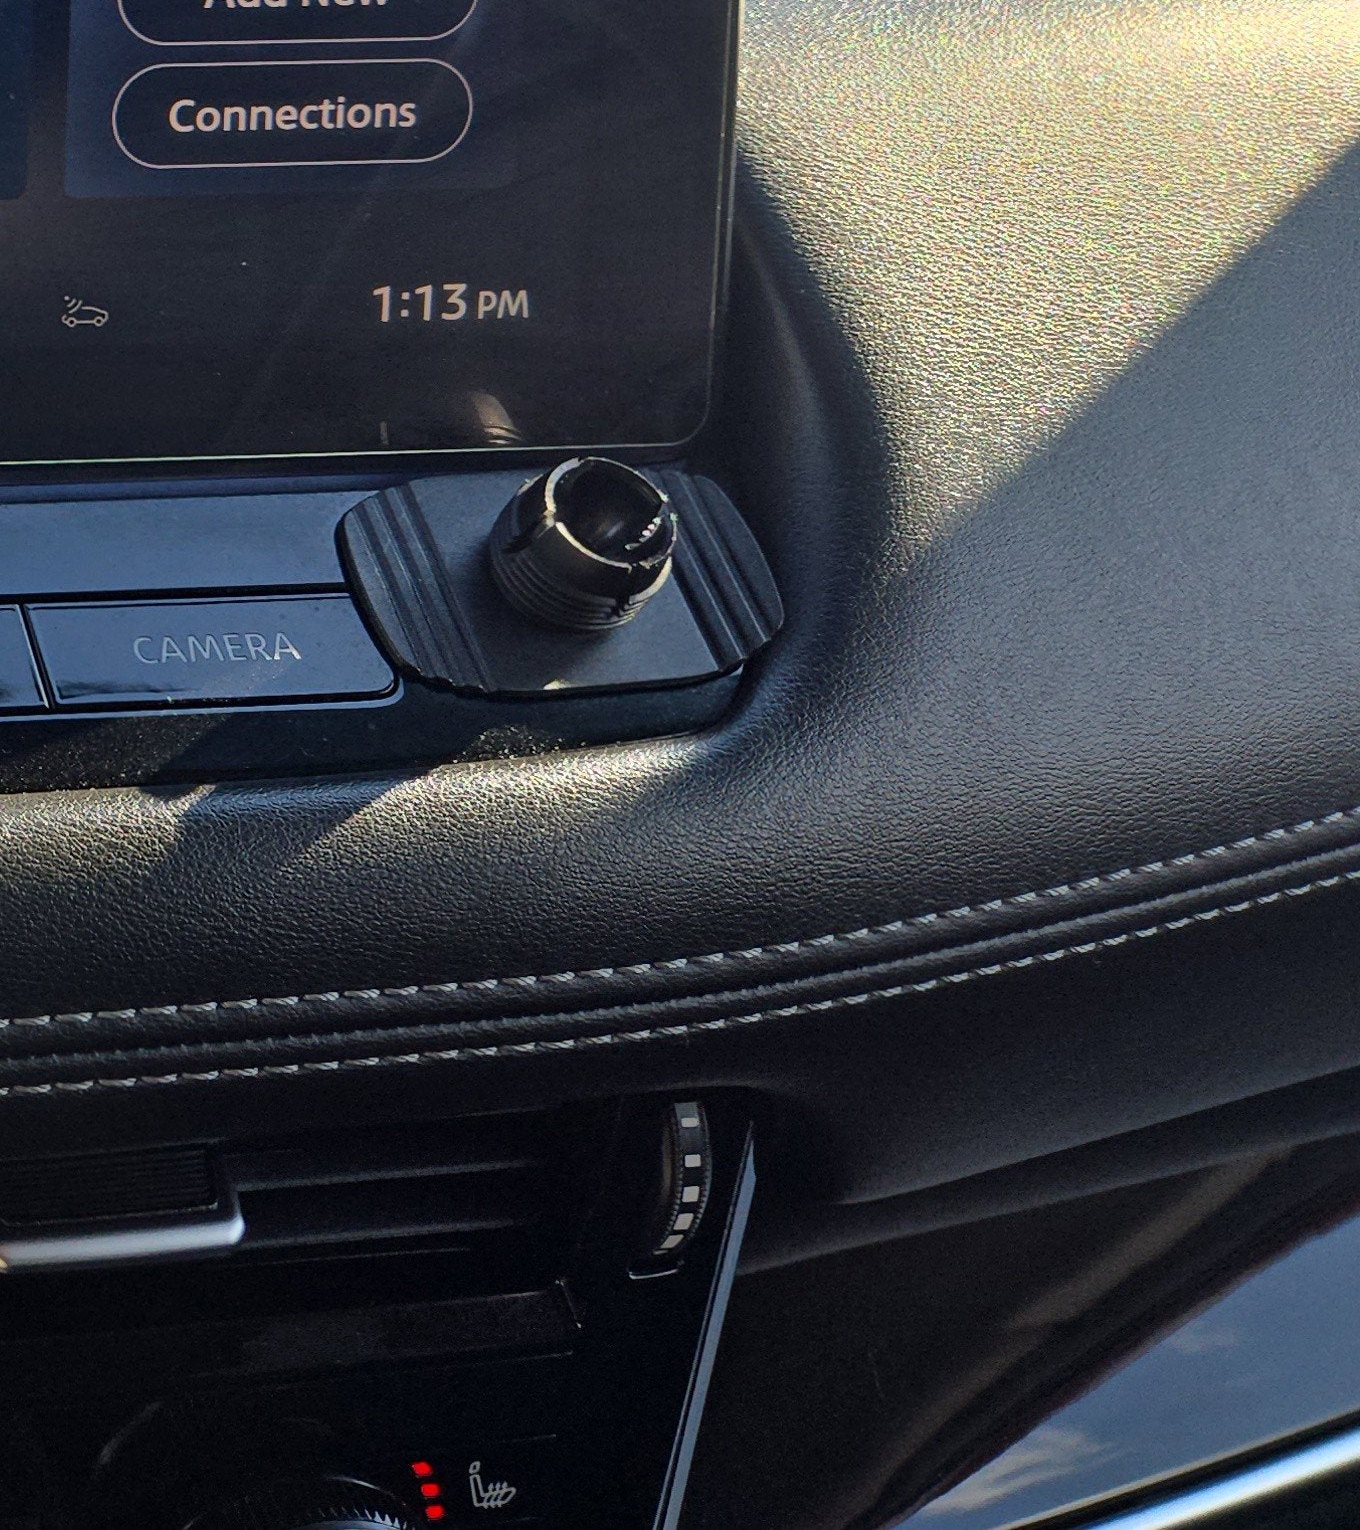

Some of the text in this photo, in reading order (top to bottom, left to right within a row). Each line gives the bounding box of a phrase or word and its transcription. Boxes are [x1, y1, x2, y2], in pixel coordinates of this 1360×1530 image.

[168, 95, 417, 134] Connections
[372, 282, 530, 324] 1:13 PM
[132, 631, 303, 665] CAMERA
